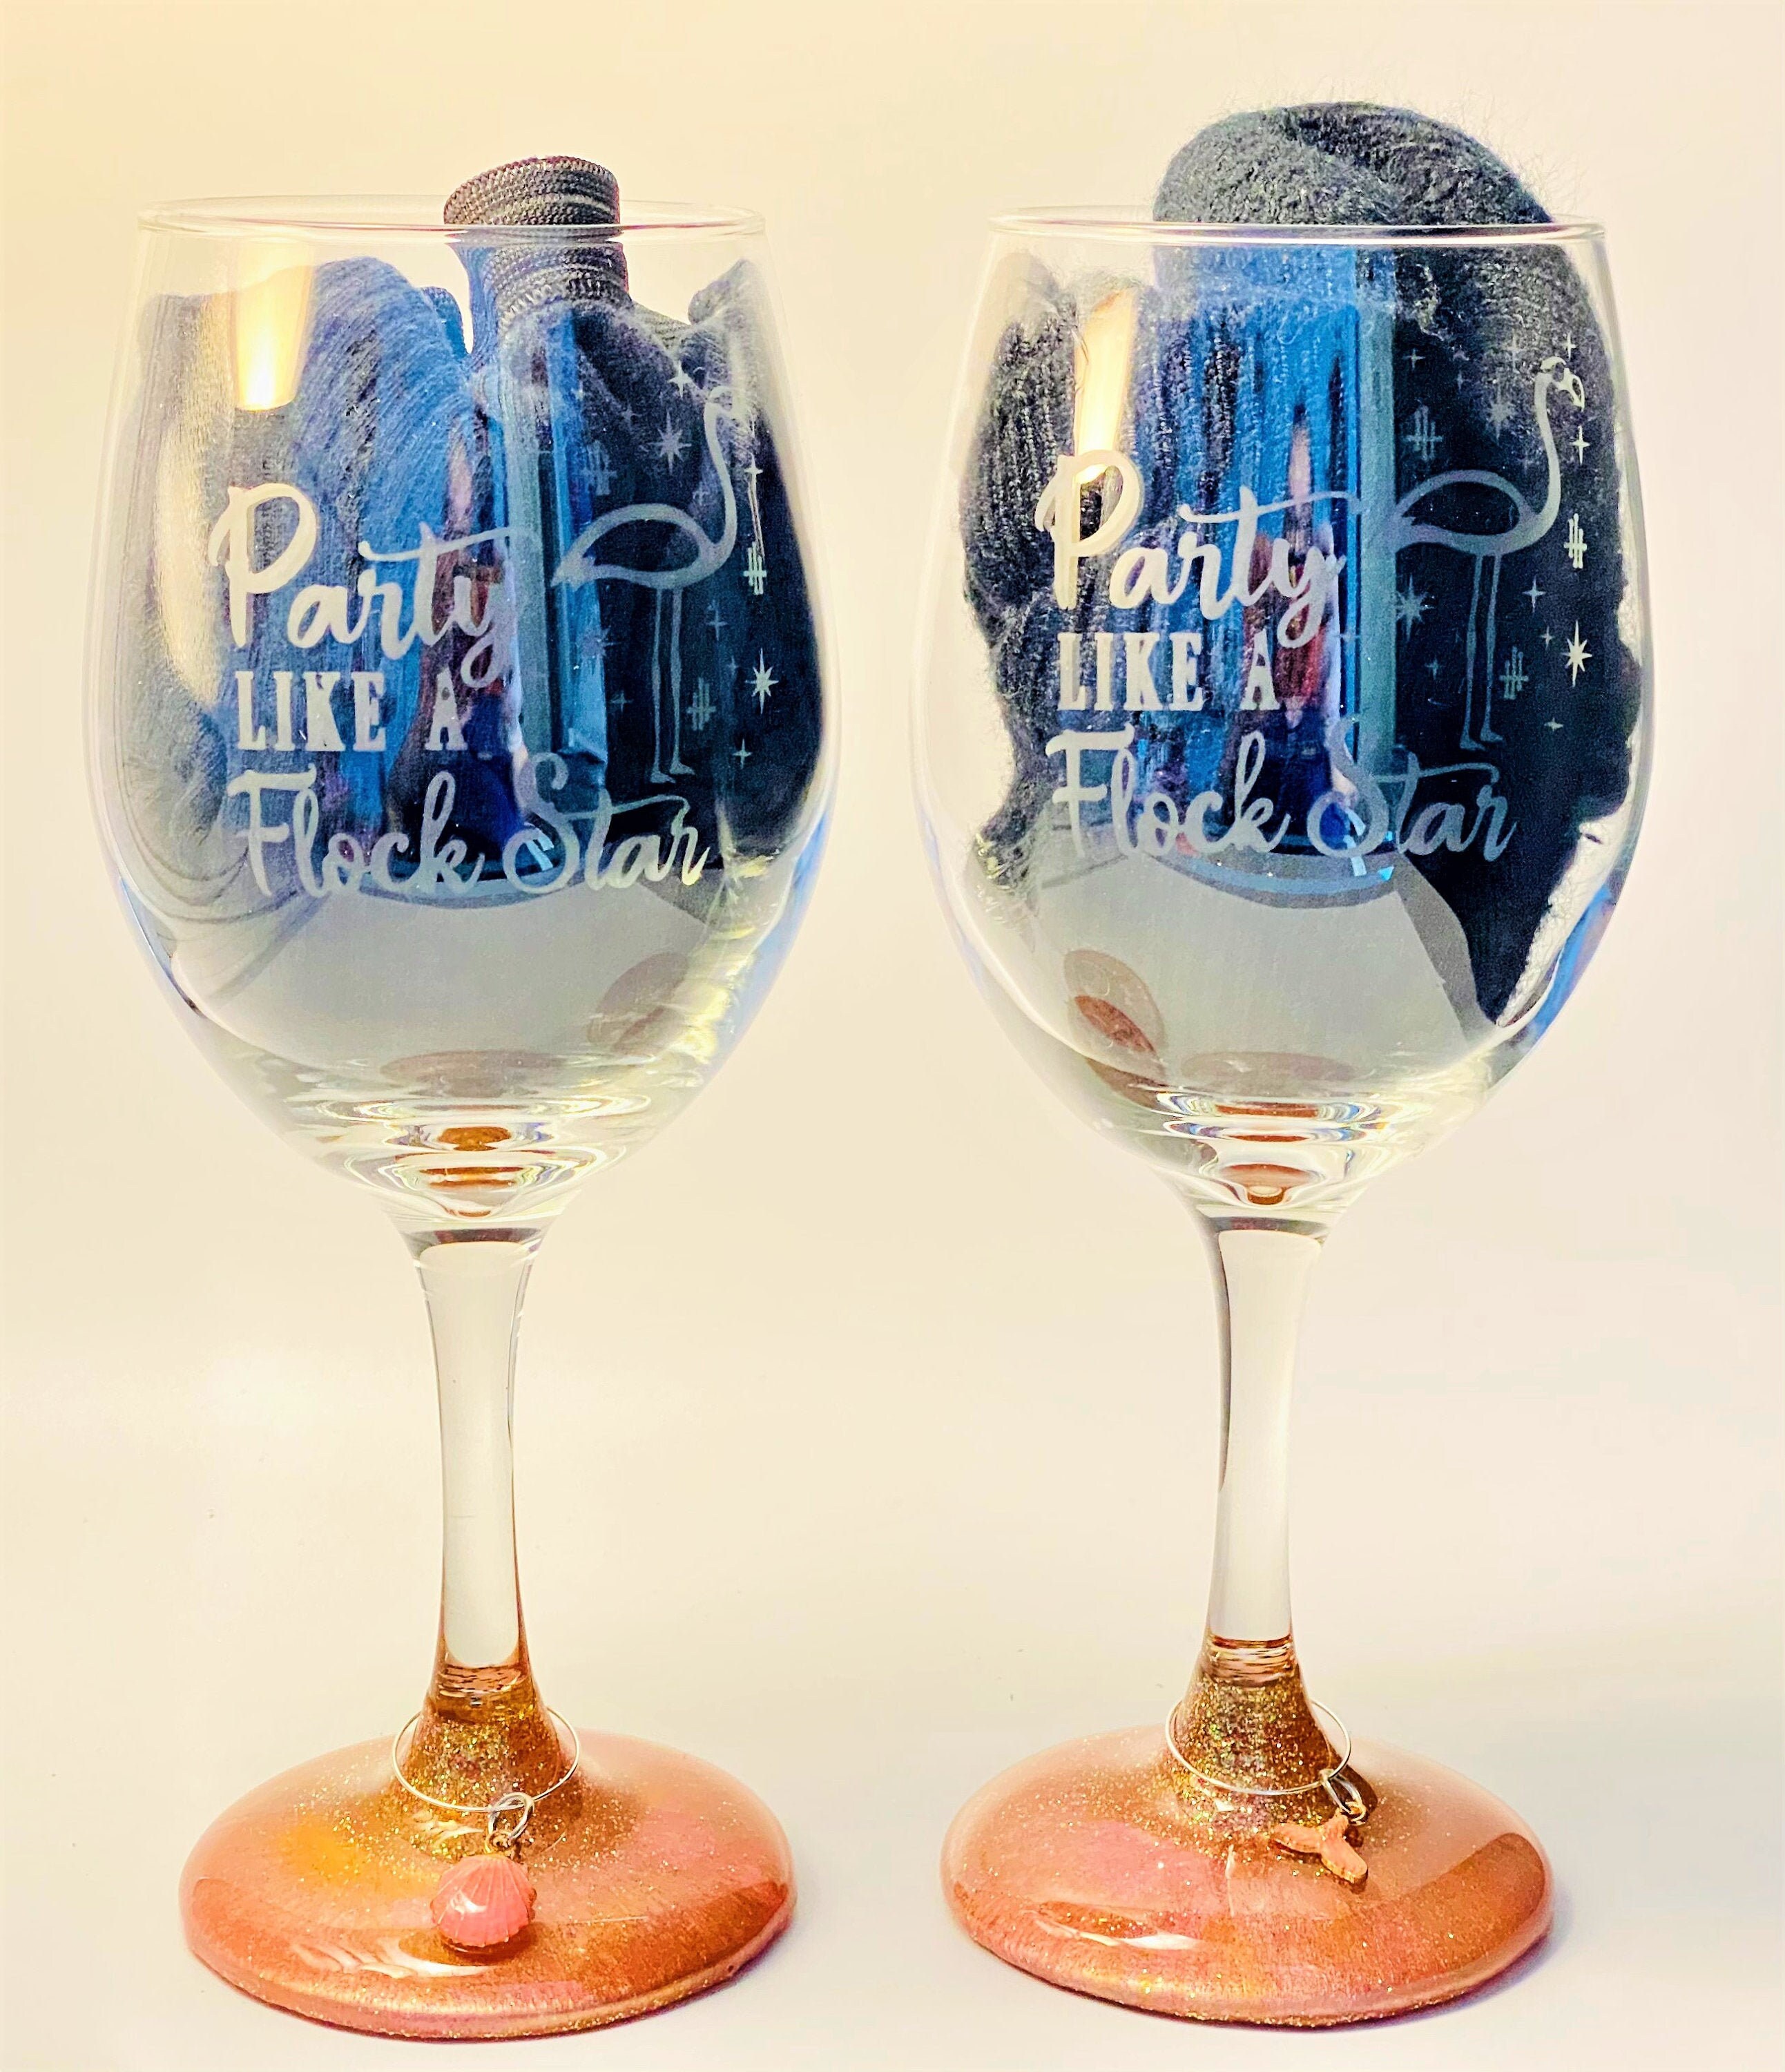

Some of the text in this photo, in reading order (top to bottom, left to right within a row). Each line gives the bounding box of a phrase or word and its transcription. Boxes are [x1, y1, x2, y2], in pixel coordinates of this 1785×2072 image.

[209, 483, 532, 689] Party
[1036, 450, 1359, 649] Party
[235, 671, 468, 751] LIKE A
[1056, 632, 1281, 711] LIKE A
[228, 753, 710, 898] Flock Star
[1045, 713, 1516, 861] Flock Star
